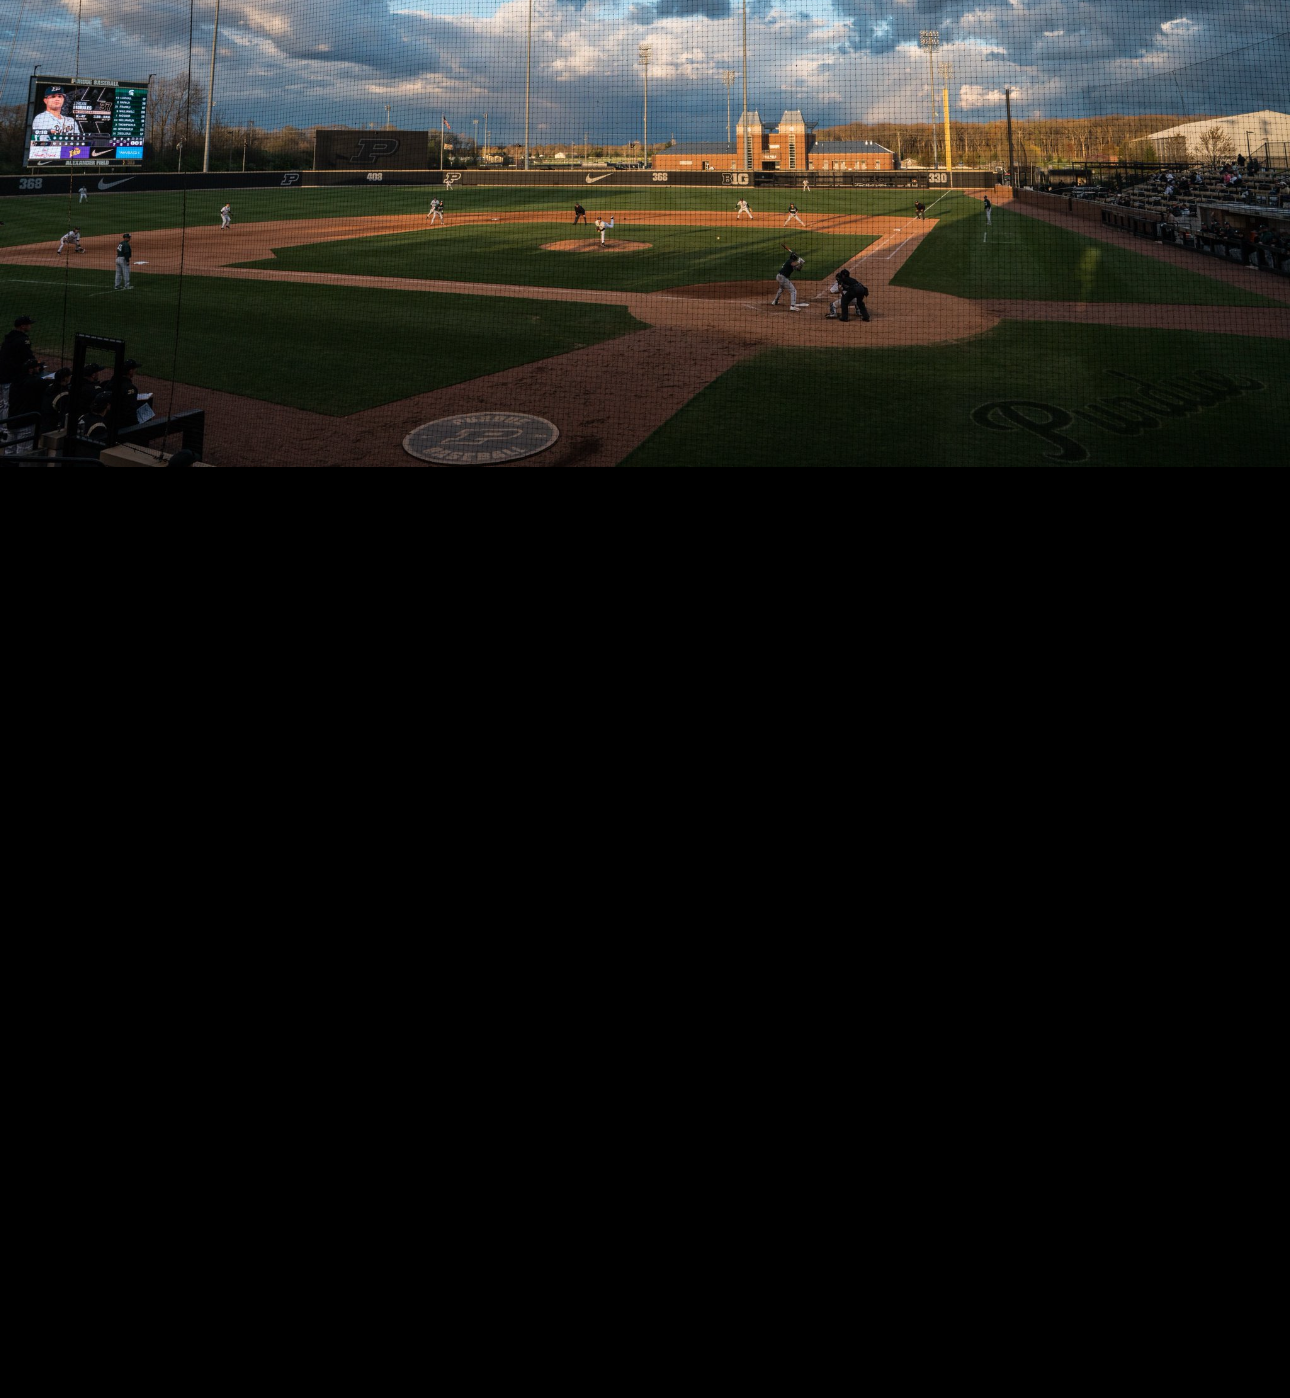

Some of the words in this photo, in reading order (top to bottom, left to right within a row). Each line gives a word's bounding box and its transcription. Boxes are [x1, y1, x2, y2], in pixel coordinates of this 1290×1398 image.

[350, 138, 399, 163] P
[280, 173, 300, 186] P
[367, 172, 383, 181] 408
[652, 173, 668, 181] 368
[929, 173, 947, 183] 330
[19, 178, 43, 190] 368
[970, 369, 1266, 462] Purdue
[423, 447, 525, 461] BASEBALL
